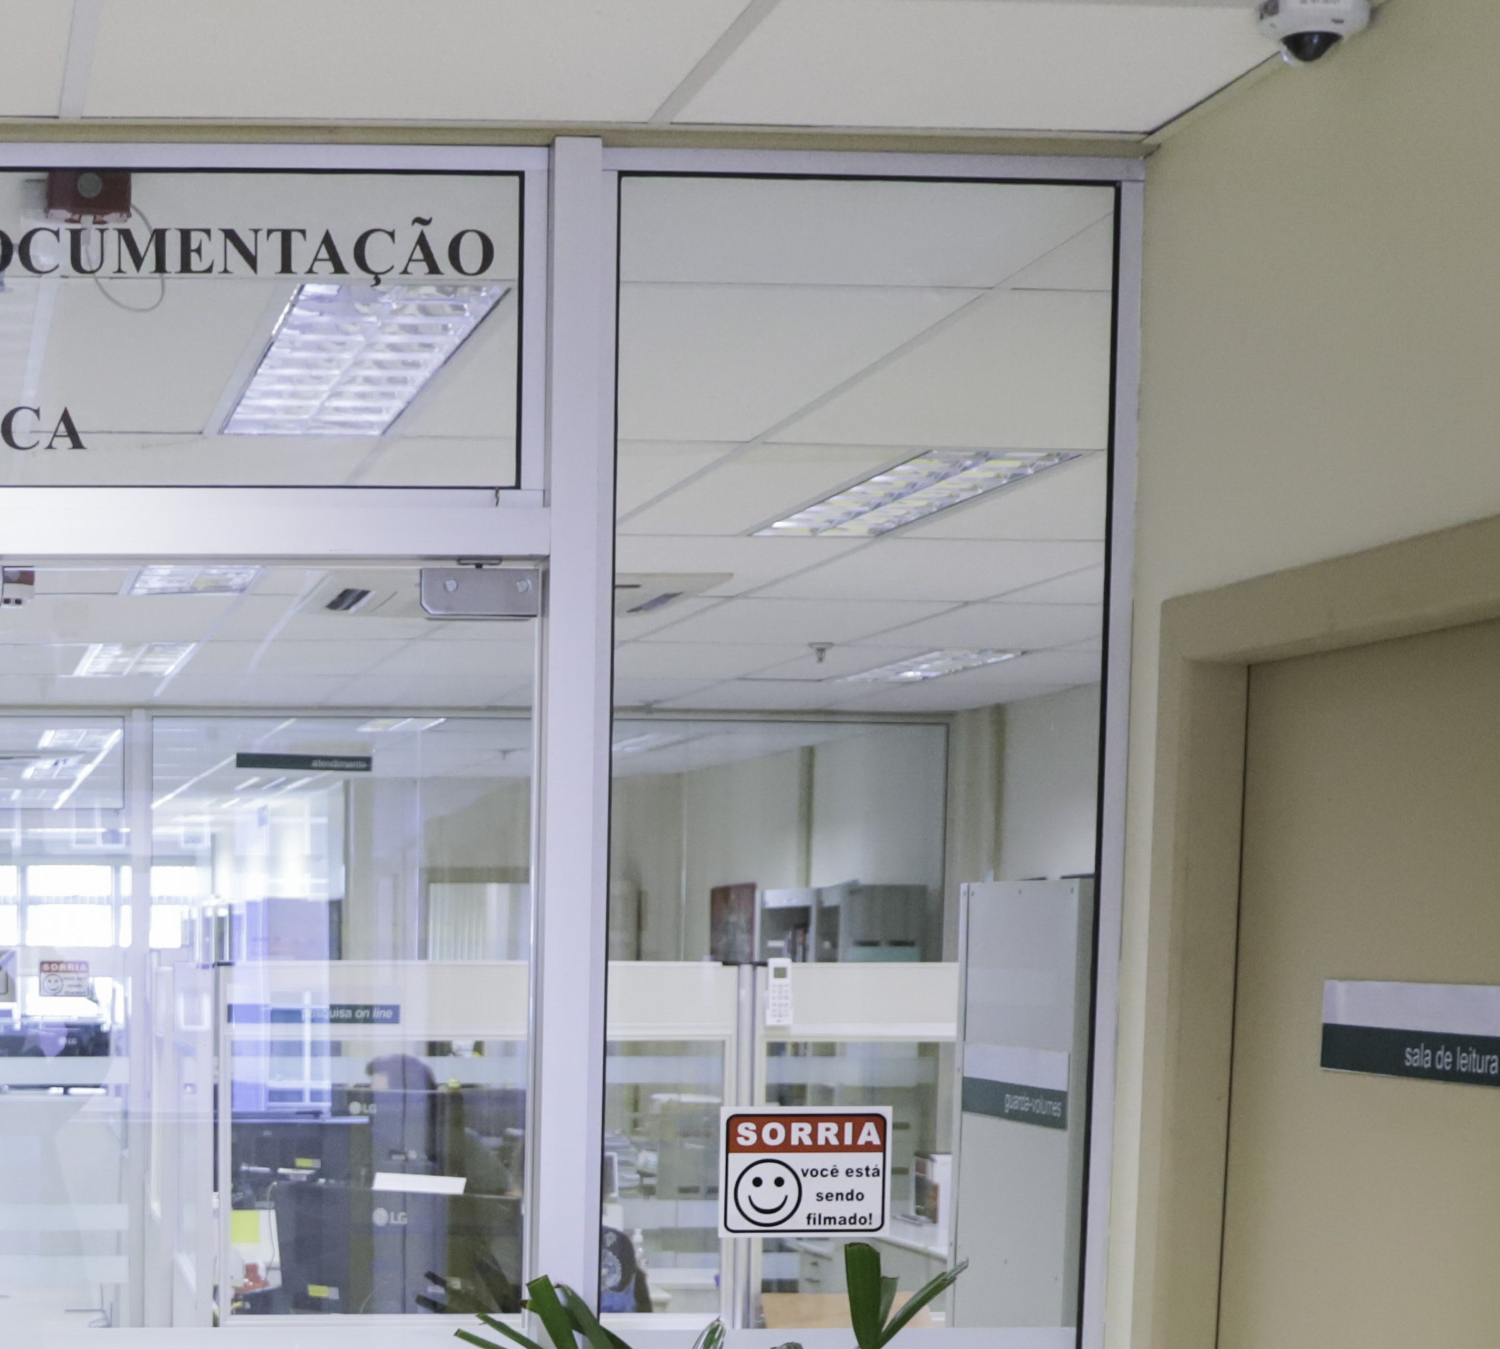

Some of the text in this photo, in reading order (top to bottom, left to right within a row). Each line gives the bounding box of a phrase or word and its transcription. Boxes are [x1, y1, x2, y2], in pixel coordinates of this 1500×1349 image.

[43, 963, 88, 972] SORRIA
[355, 1009, 370, 1019] on
[372, 1007, 393, 1019] line
[1404, 1043, 1500, 1074] sala de leitura
[363, 1104, 377, 1114] LG
[736, 1121, 882, 1147] SORRIA
[801, 1164, 881, 1178] você está
[815, 1189, 865, 1202] sendo
[389, 1211, 408, 1225] LG
[806, 1213, 873, 1226] filmado!
